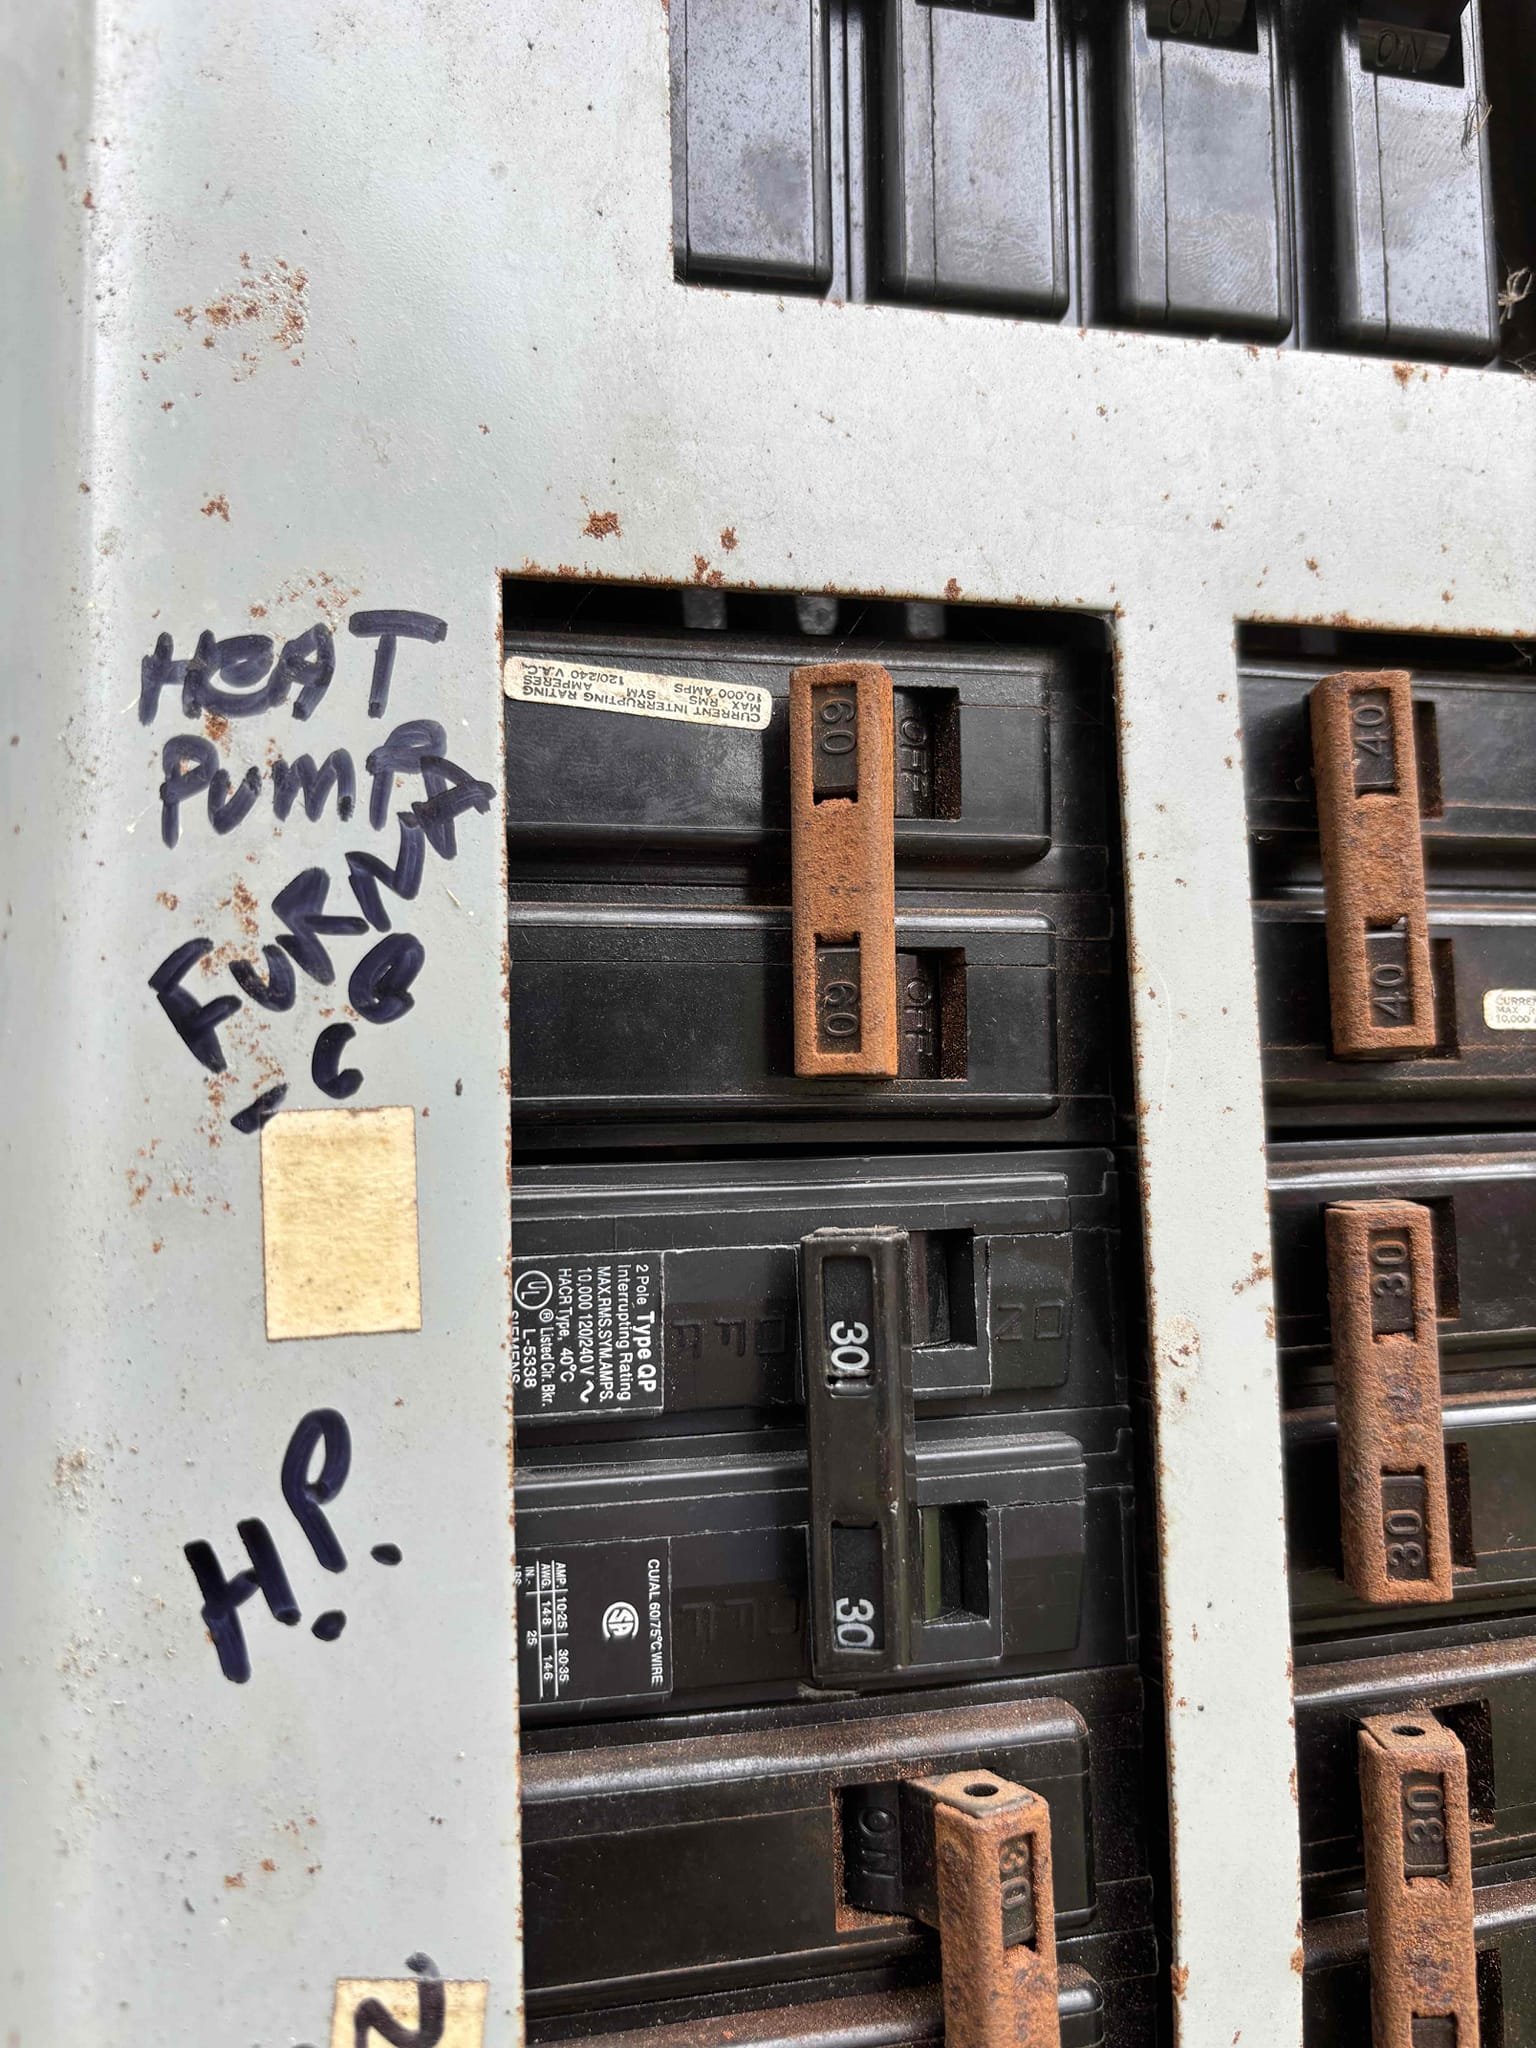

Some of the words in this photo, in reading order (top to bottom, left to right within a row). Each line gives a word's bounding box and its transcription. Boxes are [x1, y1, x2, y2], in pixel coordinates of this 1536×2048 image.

[523, 675, 592, 691] AMPERES
[523, 686, 577, 699] RATING
[570, 670, 624, 685] 120/240
[626, 688, 656, 699] SYM
[673, 684, 713, 696] AMPS
[584, 692, 688, 714] INTERRUPTING
[689, 696, 718, 707] RMS
[693, 706, 760, 722] CURRENT
[732, 700, 761, 712] MAX
[1353, 704, 1389, 758] 40
[1373, 963, 1409, 1019] 40
[1496, 995, 1536, 1005] CURRE
[636, 1264, 649, 1272] 2
[1373, 1240, 1409, 1297] 30
[558, 1268, 572, 1305] HACR
[576, 1267, 593, 1309] 10,000
[636, 1276, 649, 1305] Pole
[616, 1264, 632, 1349] Interrupting
[556, 1307, 572, 1341] Type,
[578, 1314, 594, 1363] 120/240
[633, 1311, 655, 1360] Type
[523, 1329, 536, 1388] L-5338
[540, 1327, 553, 1360] Listed
[830, 1320, 869, 1373] 30
[541, 1363, 555, 1381] Cir.
[560, 1347, 577, 1382] 40°C
[580, 1365, 594, 1375] V
[617, 1353, 633, 1401] Rating
[638, 1364, 656, 1392] QP
[542, 1385, 555, 1407] Bkr.
[1385, 1509, 1424, 1568] 30
[527, 1630, 537, 1645] 25
[835, 1597, 875, 1649] 30
[651, 1650, 662, 1685] WIRE
[1407, 1785, 1443, 1844] 30
